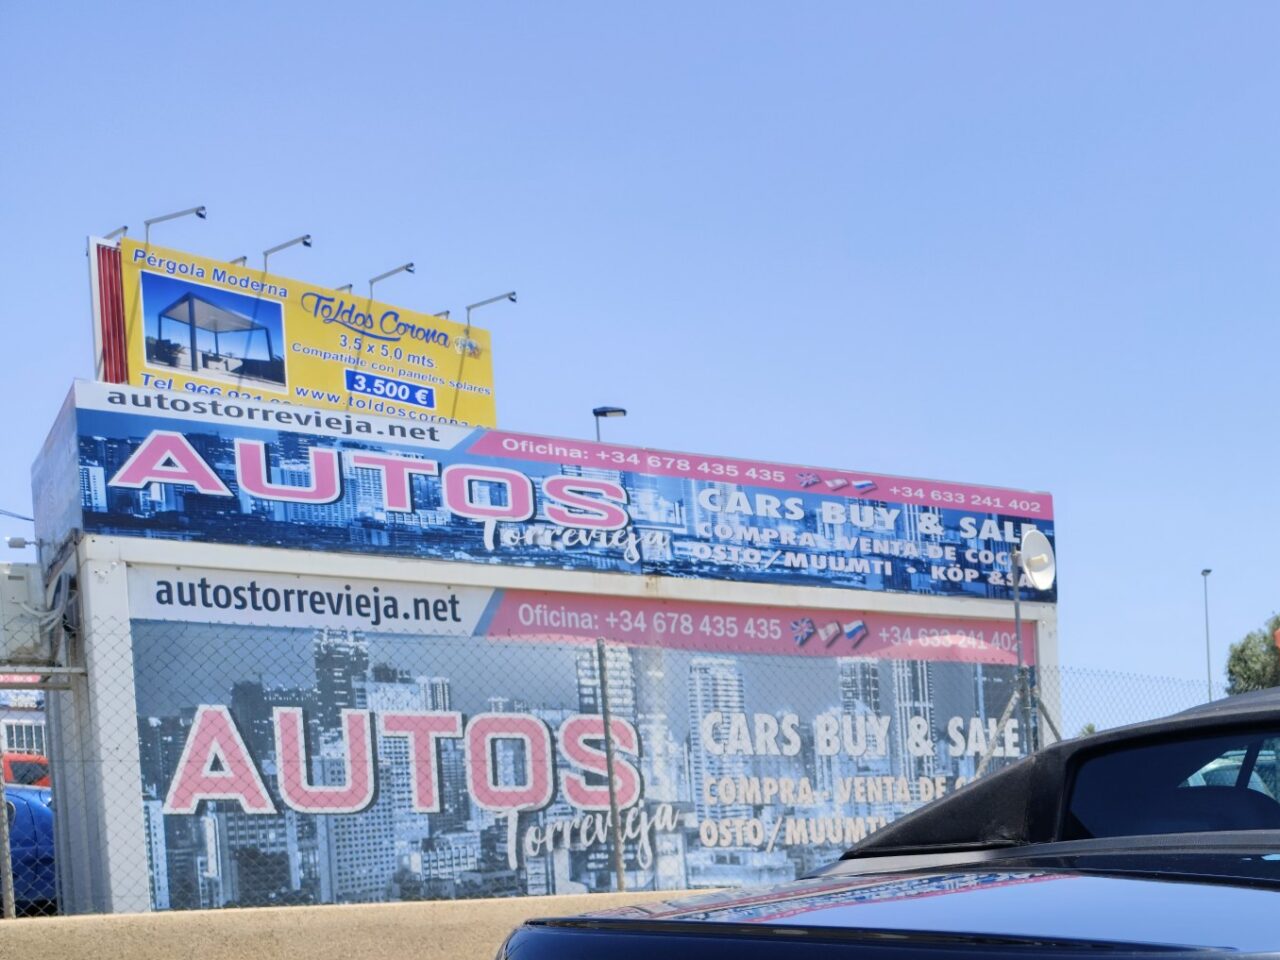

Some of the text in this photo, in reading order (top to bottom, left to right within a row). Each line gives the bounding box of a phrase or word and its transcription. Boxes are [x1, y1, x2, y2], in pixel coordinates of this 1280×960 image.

[133, 249, 288, 298] Pérgola Moderna
[301, 292, 450, 348] Toldos Corona
[292, 342, 491, 396] Compatible con paneles solares
[407, 352, 438, 368] mts.
[353, 374, 429, 405] 3.500 €
[107, 389, 440, 443] autostorrevieja.net
[106, 429, 630, 531] AUTOS
[502, 438, 786, 483] Oficina: +34 678 435 435
[699, 487, 806, 521] CARS
[821, 500, 901, 531] BUY
[918, 512, 945, 536] &
[889, 485, 1041, 513] +34 633 241 402
[477, 517, 671, 564] Torrevieja
[840, 536, 919, 558] VENTA
[927, 545, 957, 560] DE
[931, 564, 979, 583] KÖP
[155, 577, 462, 626] autostorrevieja.net
[518, 603, 782, 641] Oficina: +34 678 435 435
[878, 625, 913, 647] +34
[917, 627, 954, 648] 633
[958, 629, 988, 650] 241
[702, 710, 1020, 758] CARS BUY & SALE
[162, 704, 642, 816] AUTOS
[836, 776, 912, 805] VENTA
[918, 776, 947, 800] DE
[497, 800, 681, 870] Torreveja
